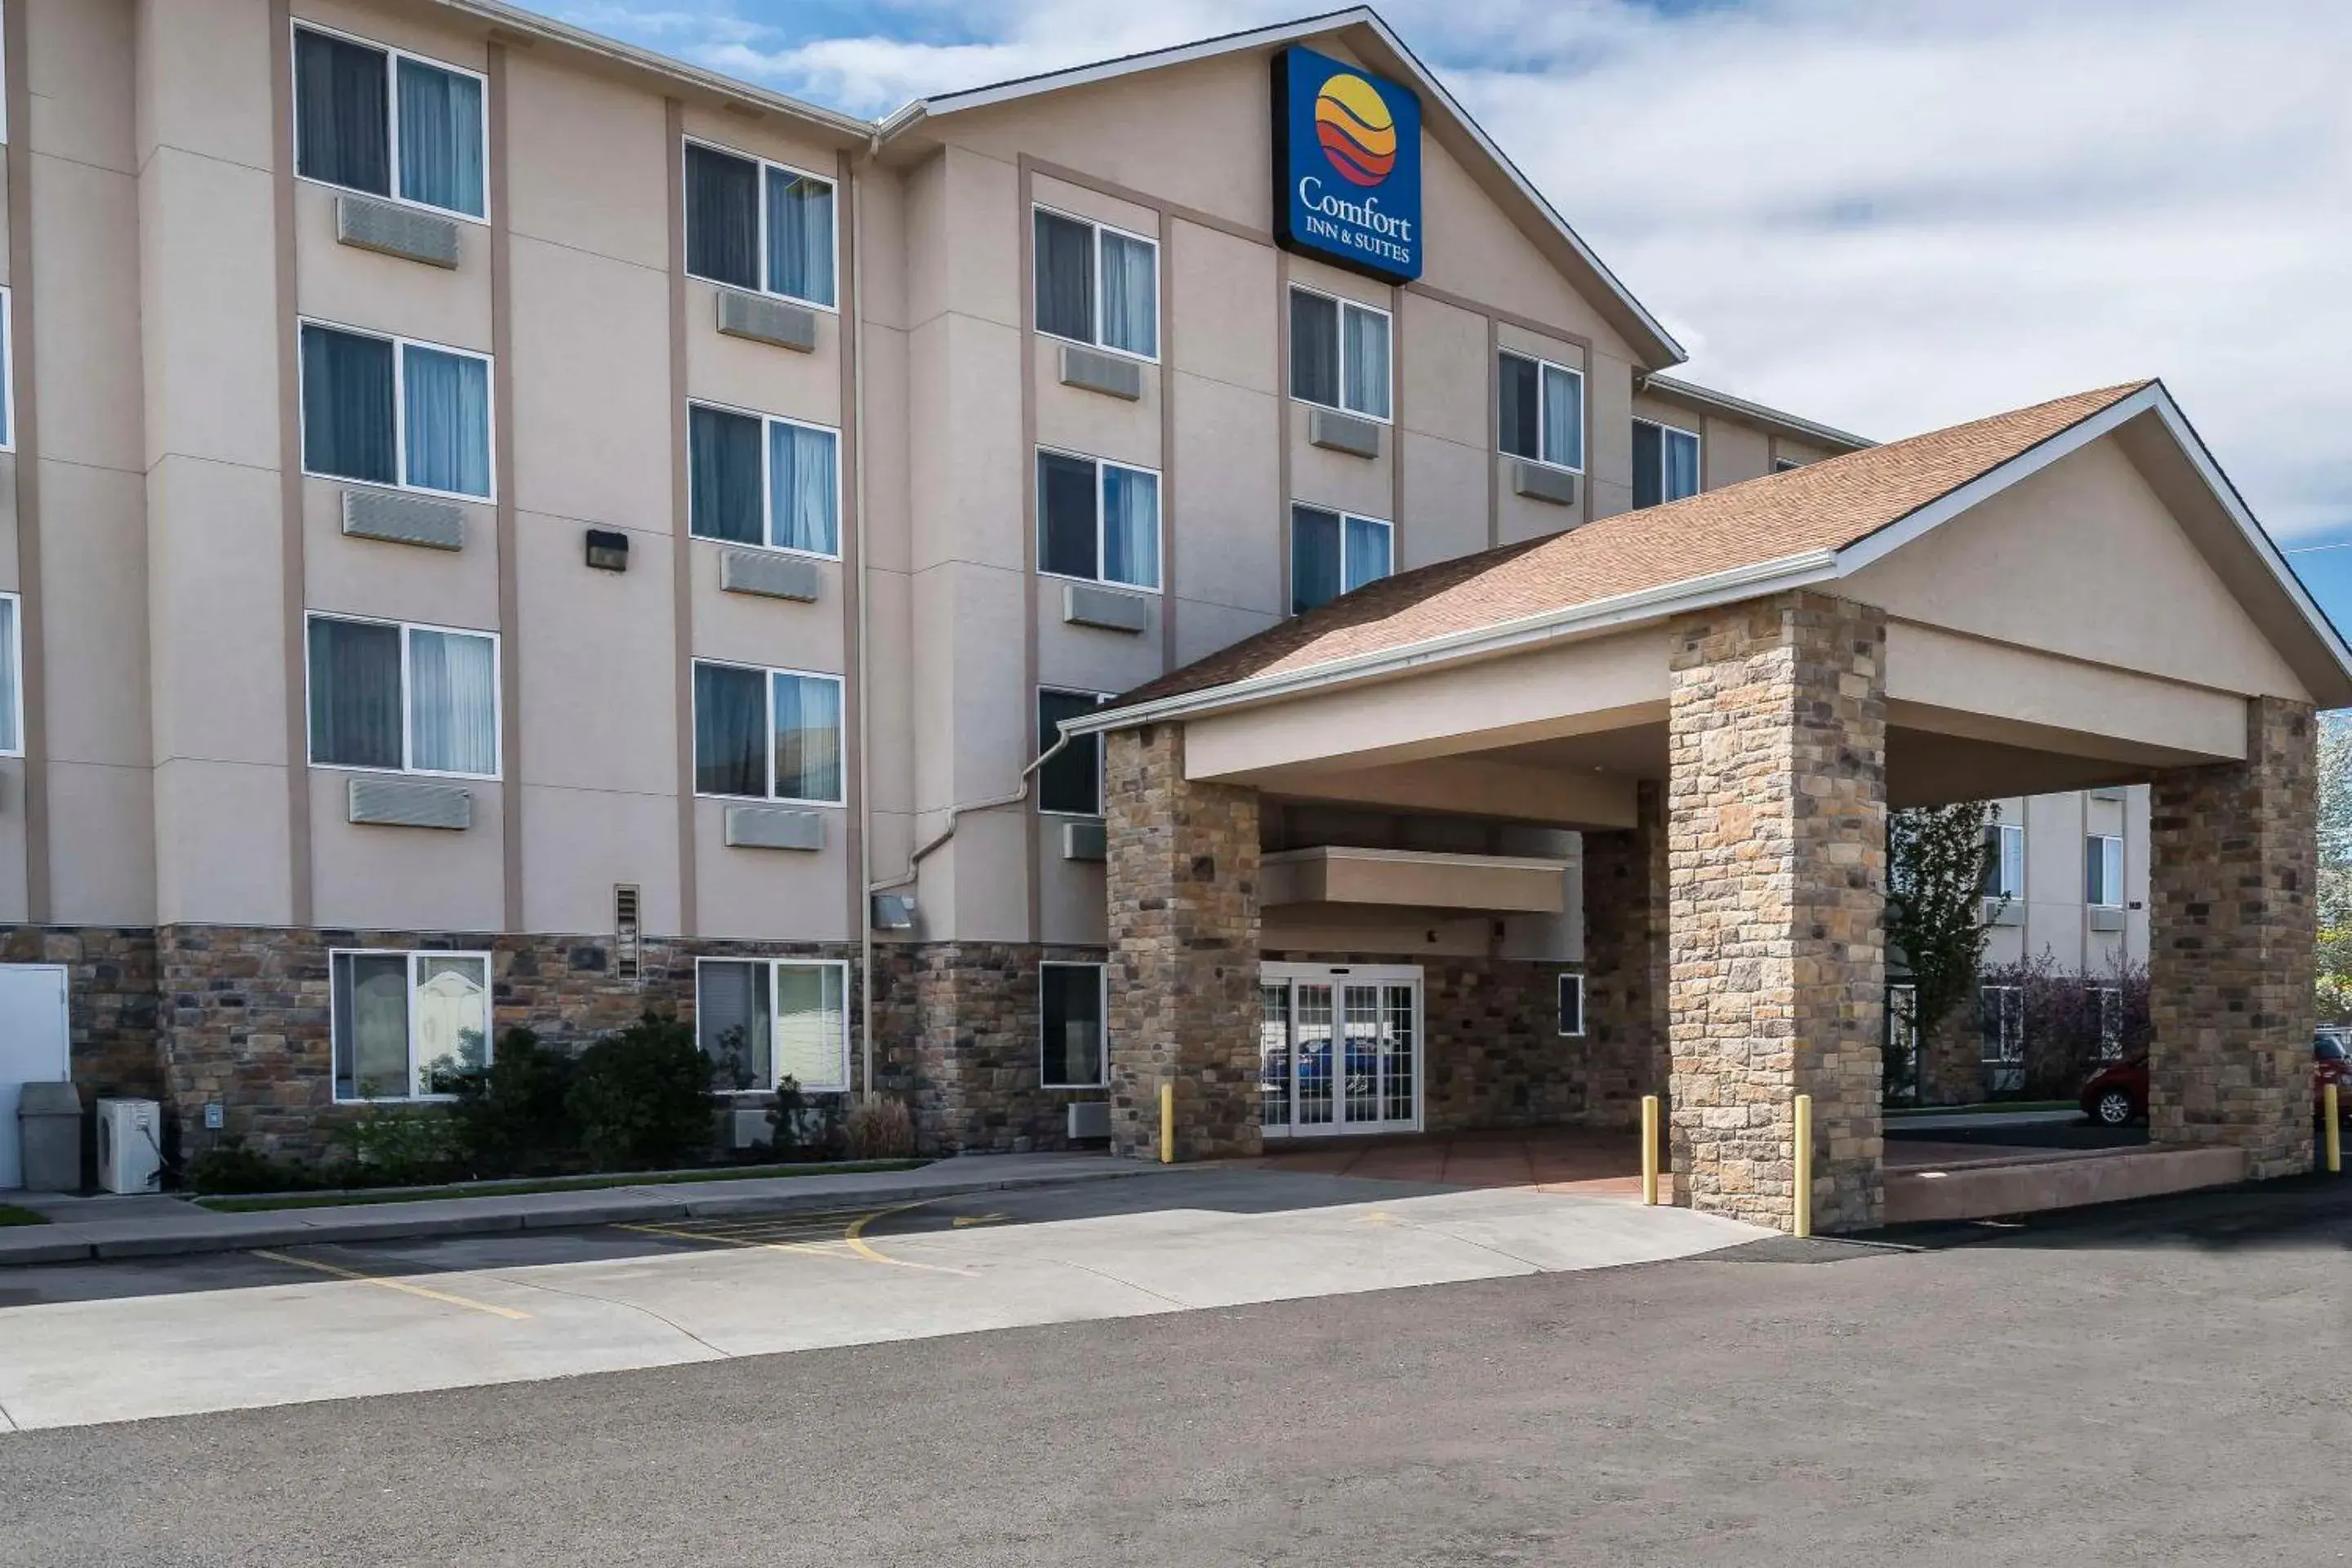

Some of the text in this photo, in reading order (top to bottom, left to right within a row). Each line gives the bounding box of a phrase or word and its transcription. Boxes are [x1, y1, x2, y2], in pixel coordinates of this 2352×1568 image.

[1298, 176, 1411, 242] Comfort
[1307, 216, 1410, 263] INN & SUITES
